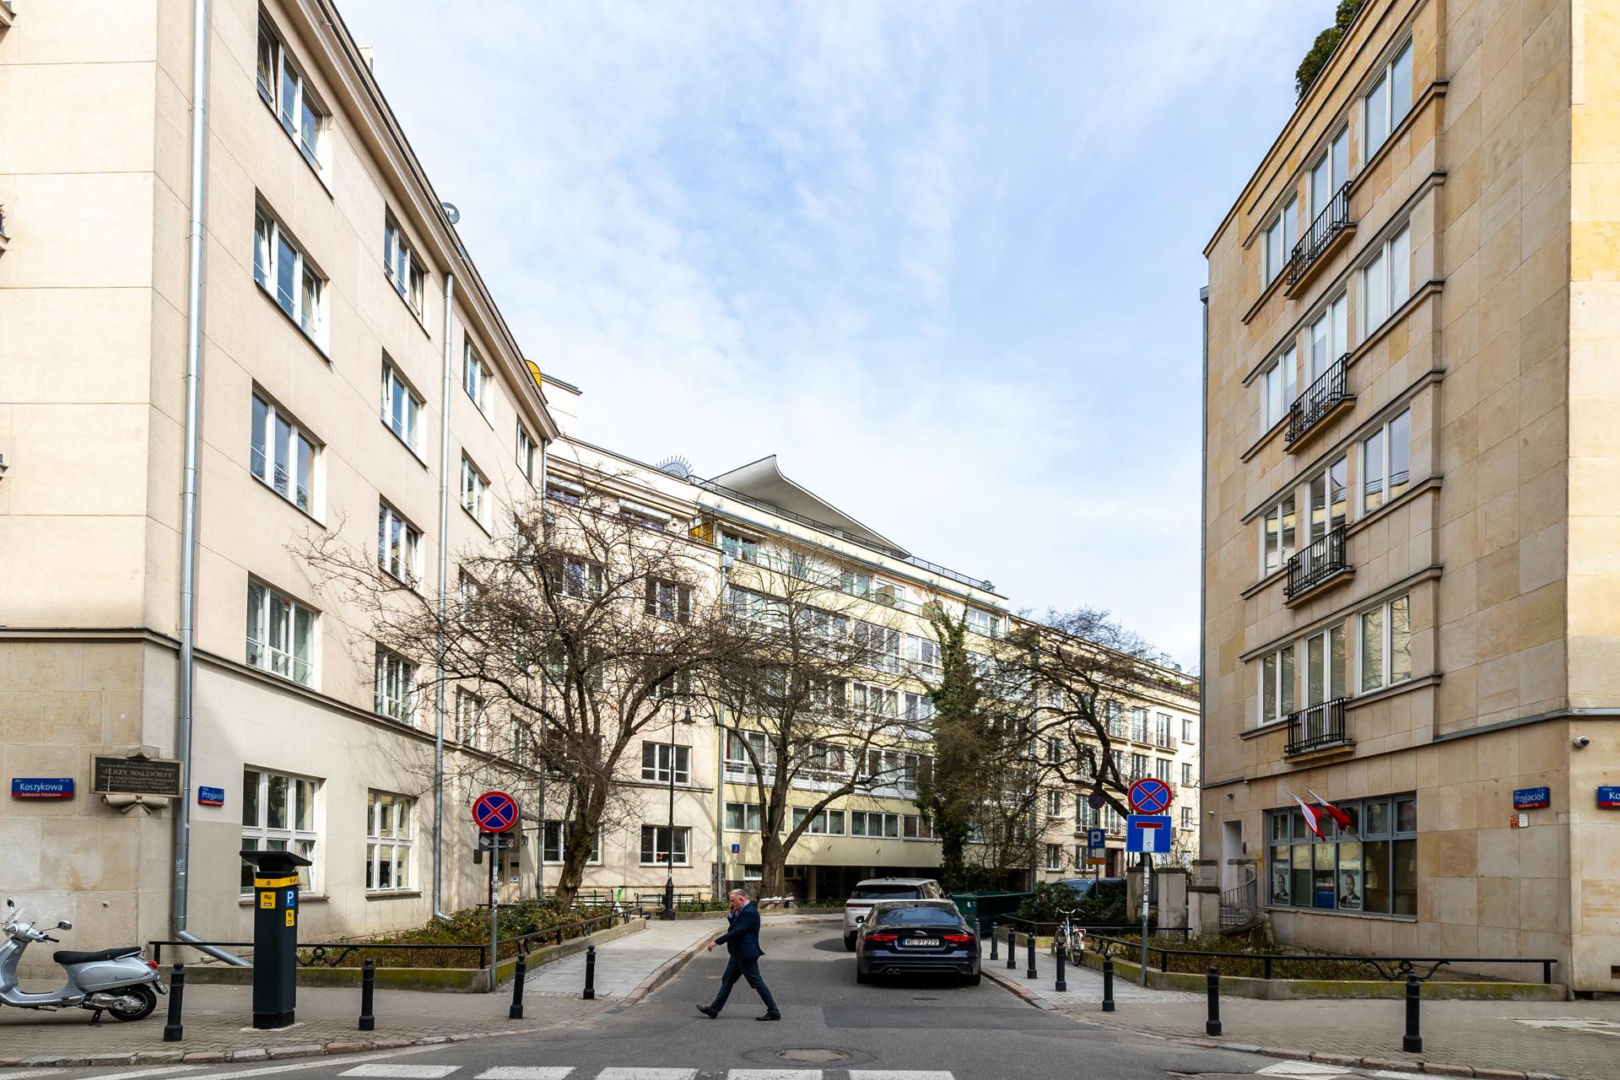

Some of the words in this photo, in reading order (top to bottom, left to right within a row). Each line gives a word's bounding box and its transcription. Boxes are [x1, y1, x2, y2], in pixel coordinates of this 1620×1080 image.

[20, 782, 63, 792] Koszykowa
[1091, 831, 1101, 846] P
[287, 891, 294, 903] P
